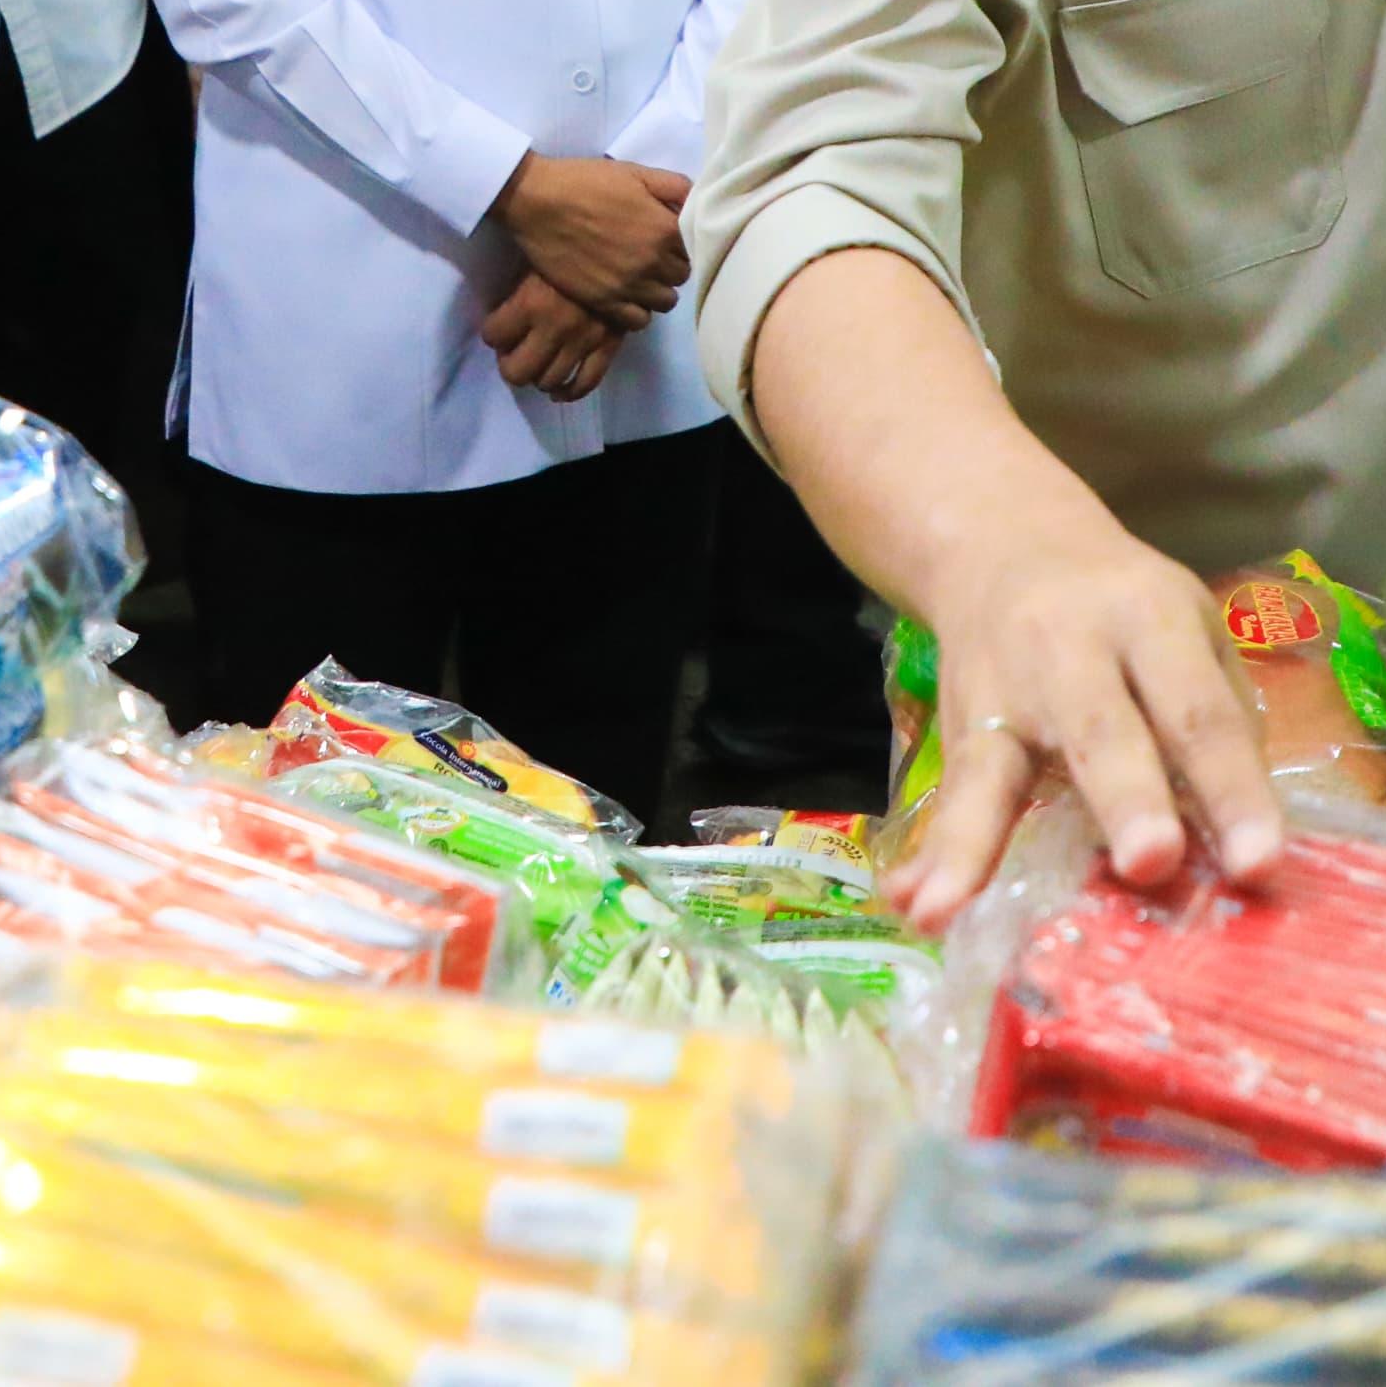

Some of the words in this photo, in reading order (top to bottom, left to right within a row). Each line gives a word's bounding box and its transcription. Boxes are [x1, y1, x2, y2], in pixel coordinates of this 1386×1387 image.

[1251, 583, 1300, 644] RAMAYANA
[419, 732, 449, 756] Cocola
[448, 752, 501, 788] International
